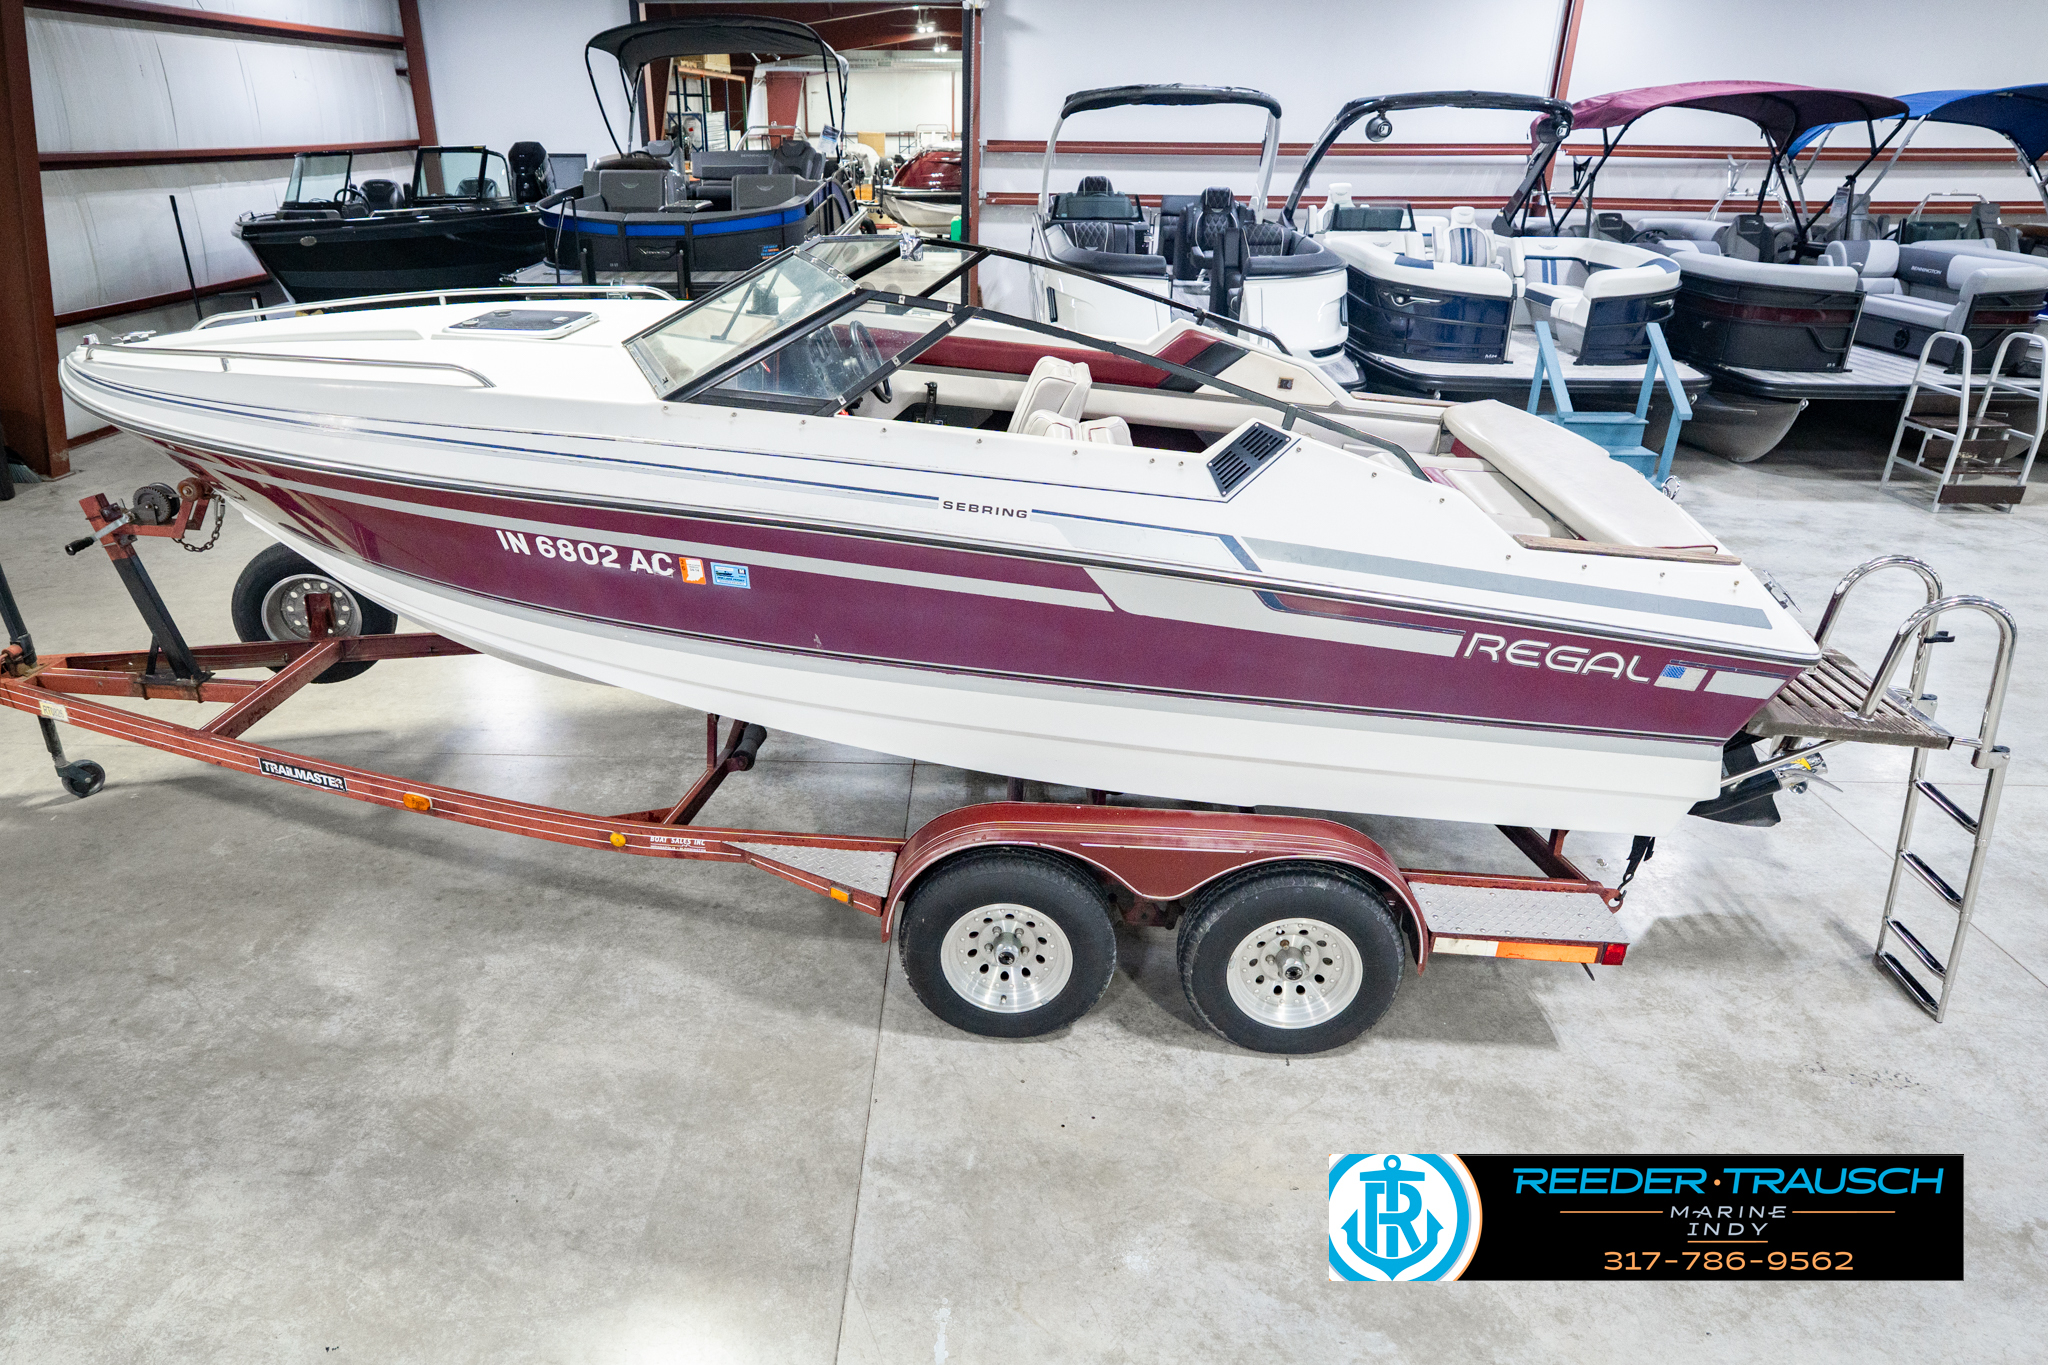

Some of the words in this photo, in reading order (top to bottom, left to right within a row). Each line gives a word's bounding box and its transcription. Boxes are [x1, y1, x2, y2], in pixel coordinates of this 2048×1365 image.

[942, 500, 1028, 519] SEBRING
[495, 529, 531, 555] IN
[535, 535, 621, 569] 6802
[630, 550, 675, 578] AC
[1462, 632, 1651, 683] REGAL
[670, 837, 691, 845] SALES
